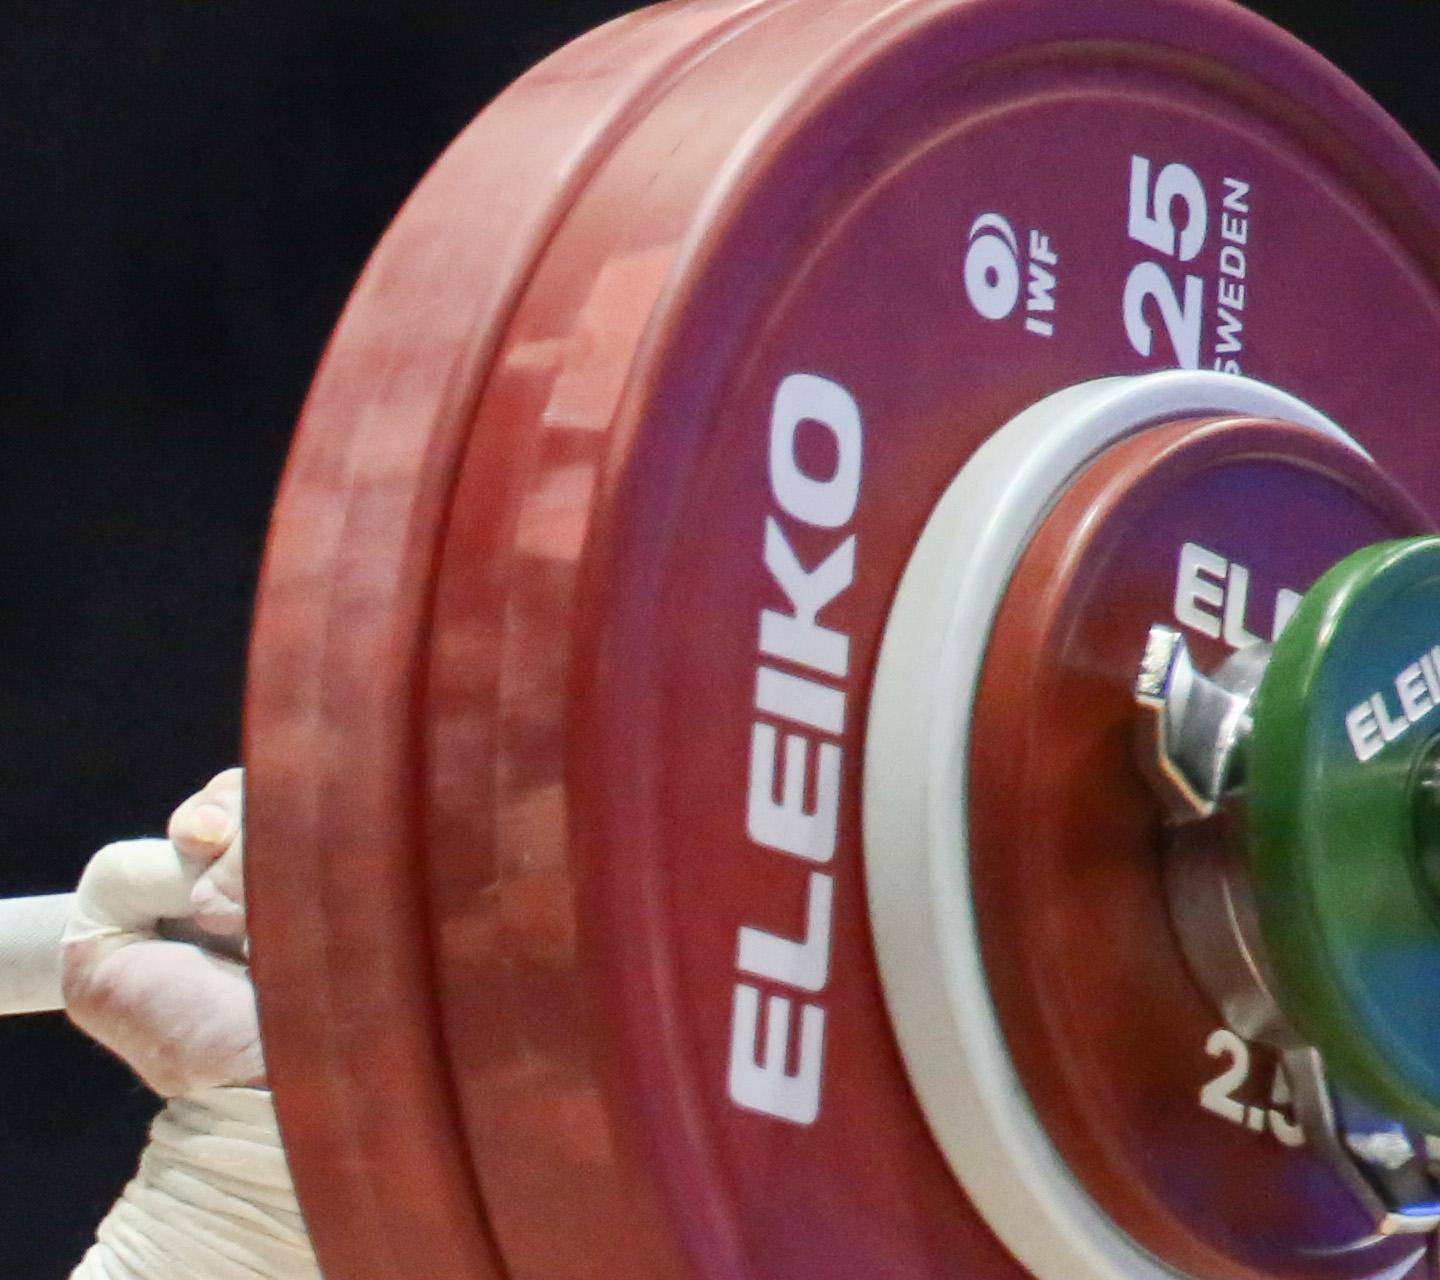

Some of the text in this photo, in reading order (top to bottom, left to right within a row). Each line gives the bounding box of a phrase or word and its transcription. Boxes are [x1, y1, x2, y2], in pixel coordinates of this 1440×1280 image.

[1025, 229, 1060, 338] IWF
[1121, 154, 1209, 370] 25
[1213, 176, 1251, 376] SWEDEN
[727, 373, 863, 1127] ELEIKO
